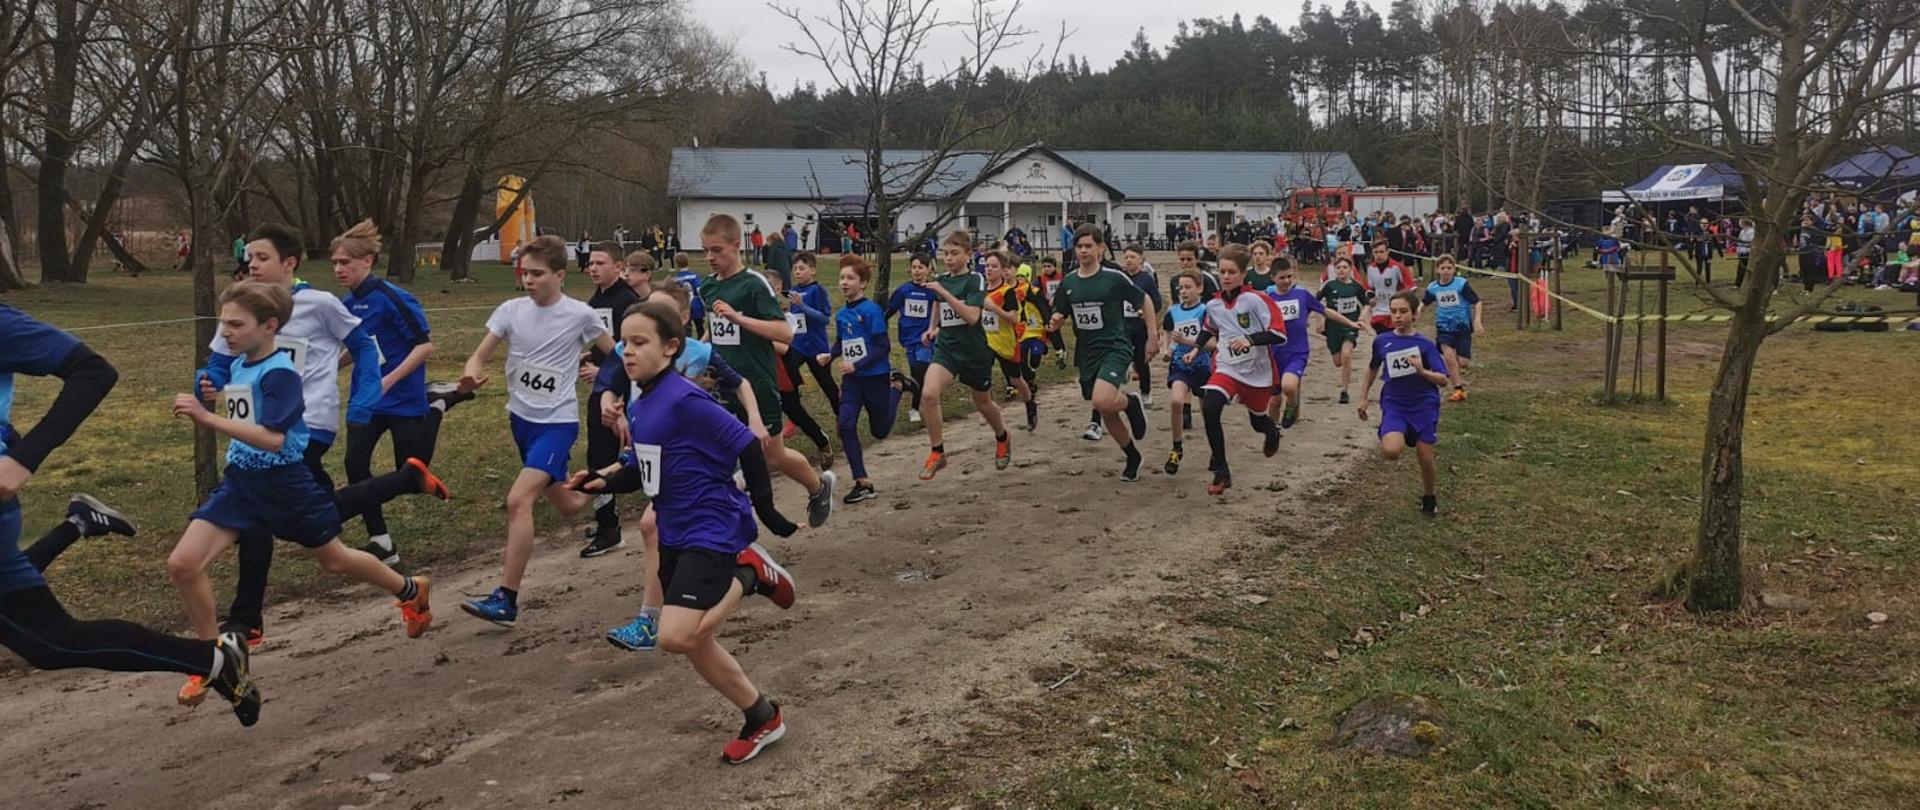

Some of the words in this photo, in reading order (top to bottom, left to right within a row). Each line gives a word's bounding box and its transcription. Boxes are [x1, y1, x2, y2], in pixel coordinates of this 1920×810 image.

[909, 304, 924, 313] 146
[1077, 313, 1099, 325] 236
[712, 321, 736, 337] 234
[520, 372, 556, 392] 464
